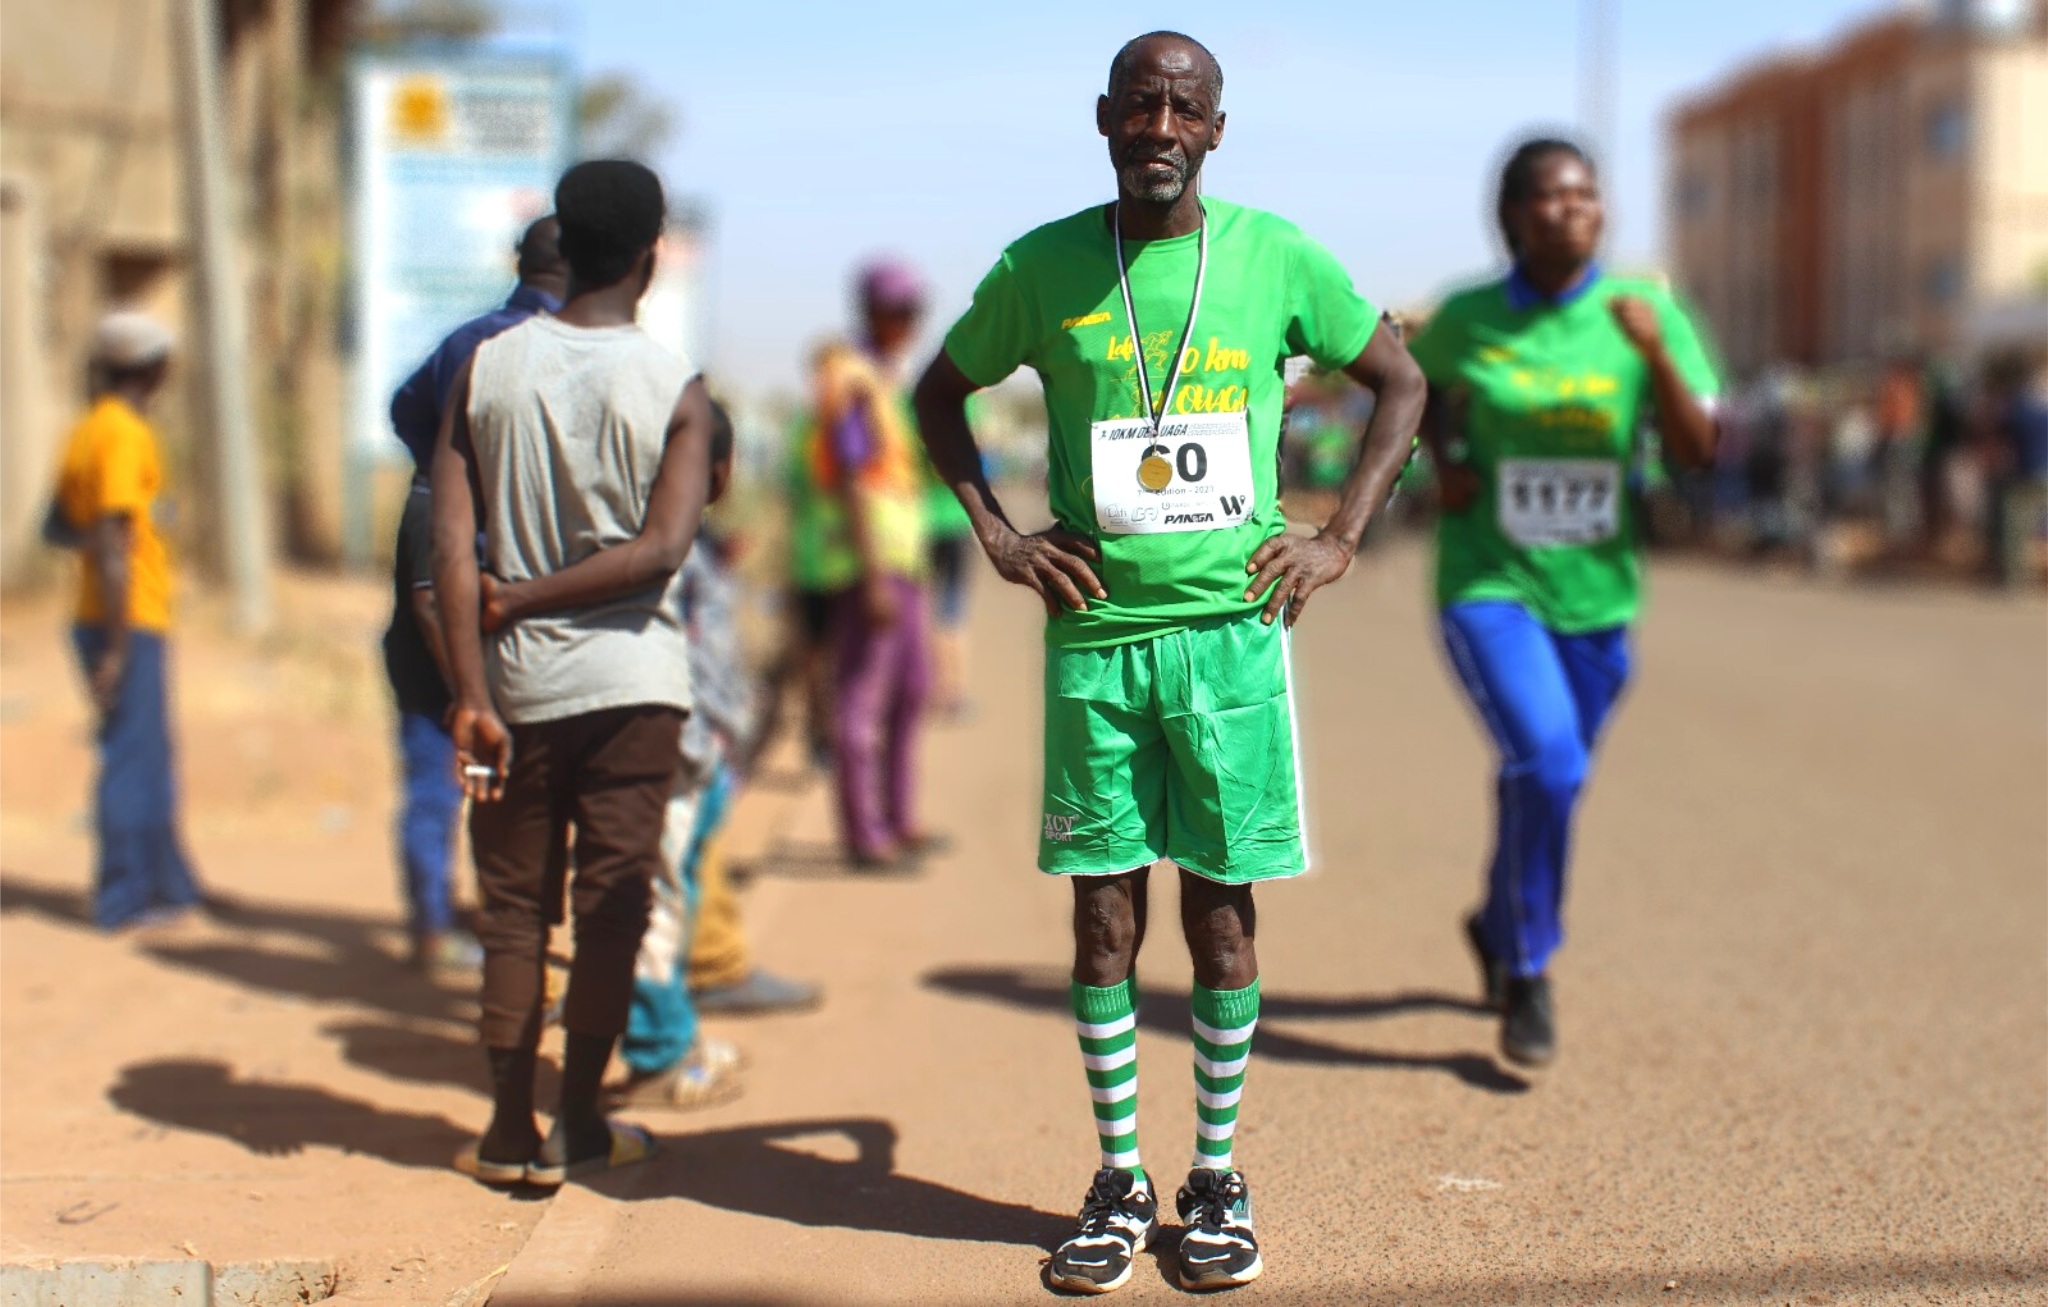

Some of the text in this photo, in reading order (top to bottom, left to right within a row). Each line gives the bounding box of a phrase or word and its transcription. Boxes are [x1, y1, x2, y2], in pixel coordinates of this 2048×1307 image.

[1204, 337, 1251, 372] km
[1157, 424, 1189, 437] UAGA
[1045, 830, 1072, 842] SPORT
